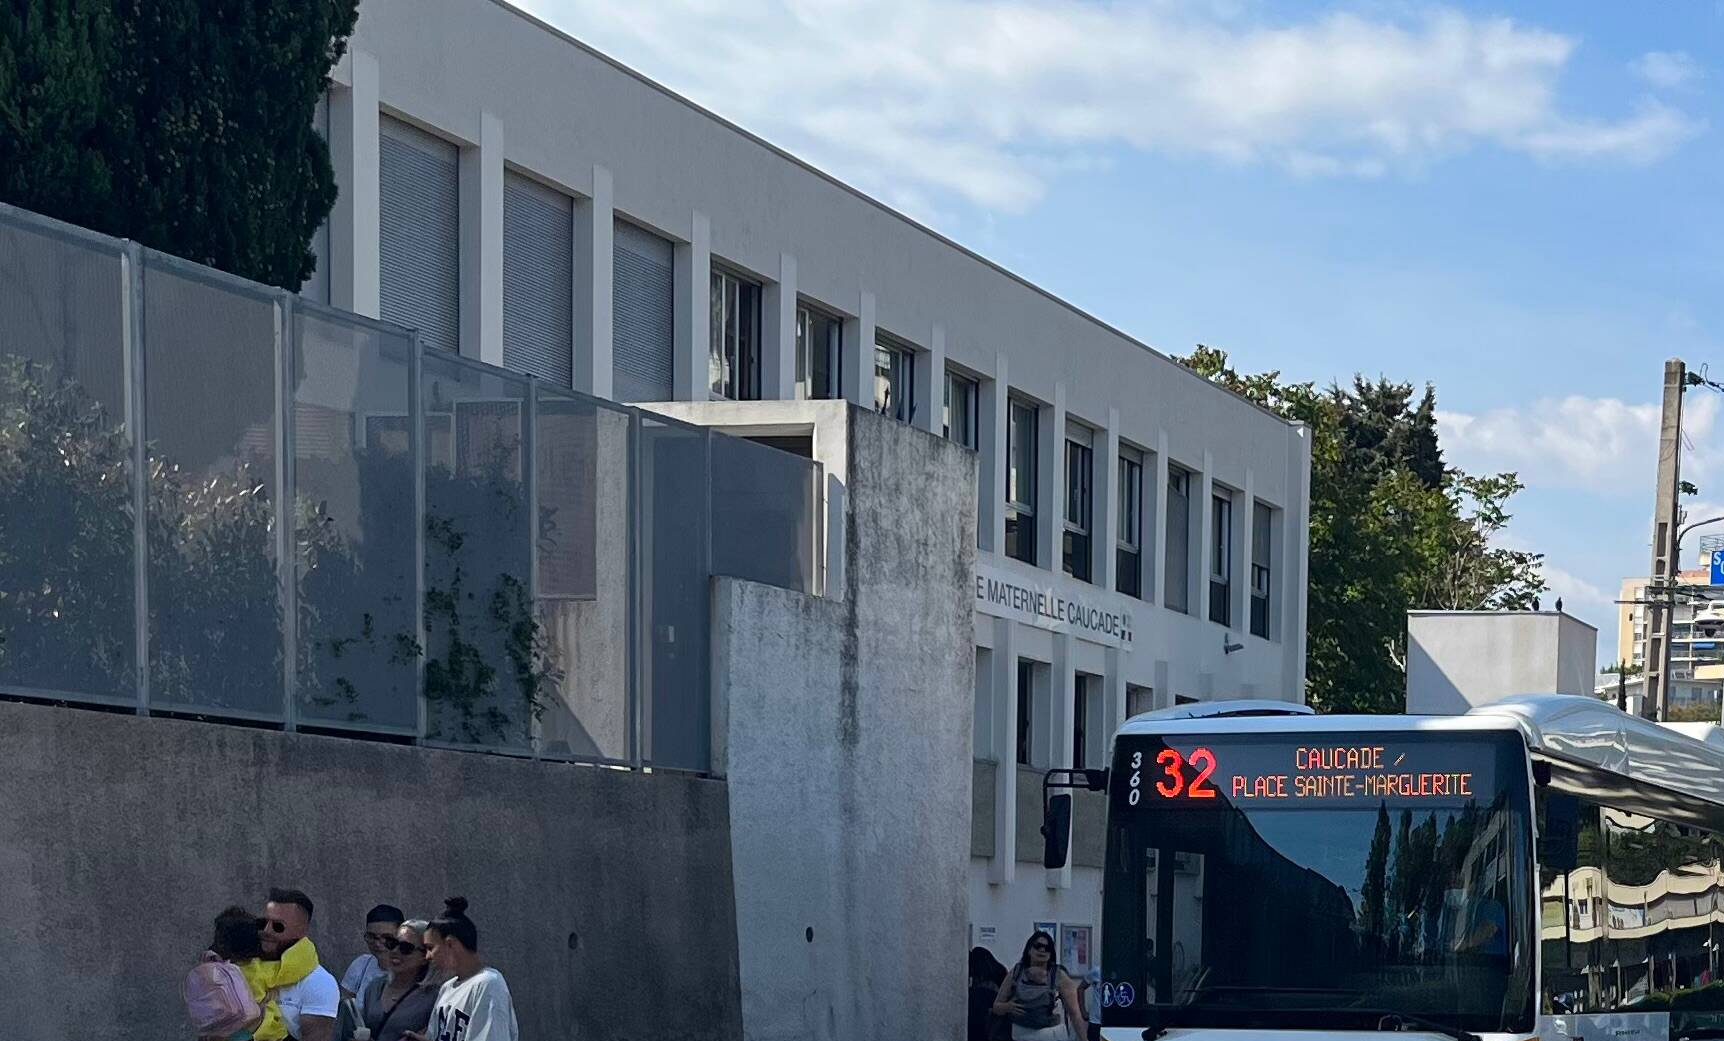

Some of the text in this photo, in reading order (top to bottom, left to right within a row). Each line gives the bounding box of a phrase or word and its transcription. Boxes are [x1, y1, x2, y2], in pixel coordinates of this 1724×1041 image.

[988, 578, 1065, 621] MATERNELLE
[1067, 602, 1119, 636] CAUCADE
[1155, 748, 1217, 798] 32
[1296, 747, 1385, 769] CAUCADE
[1232, 774, 1472, 797] PLACE SAINTE-MARGUERITE
